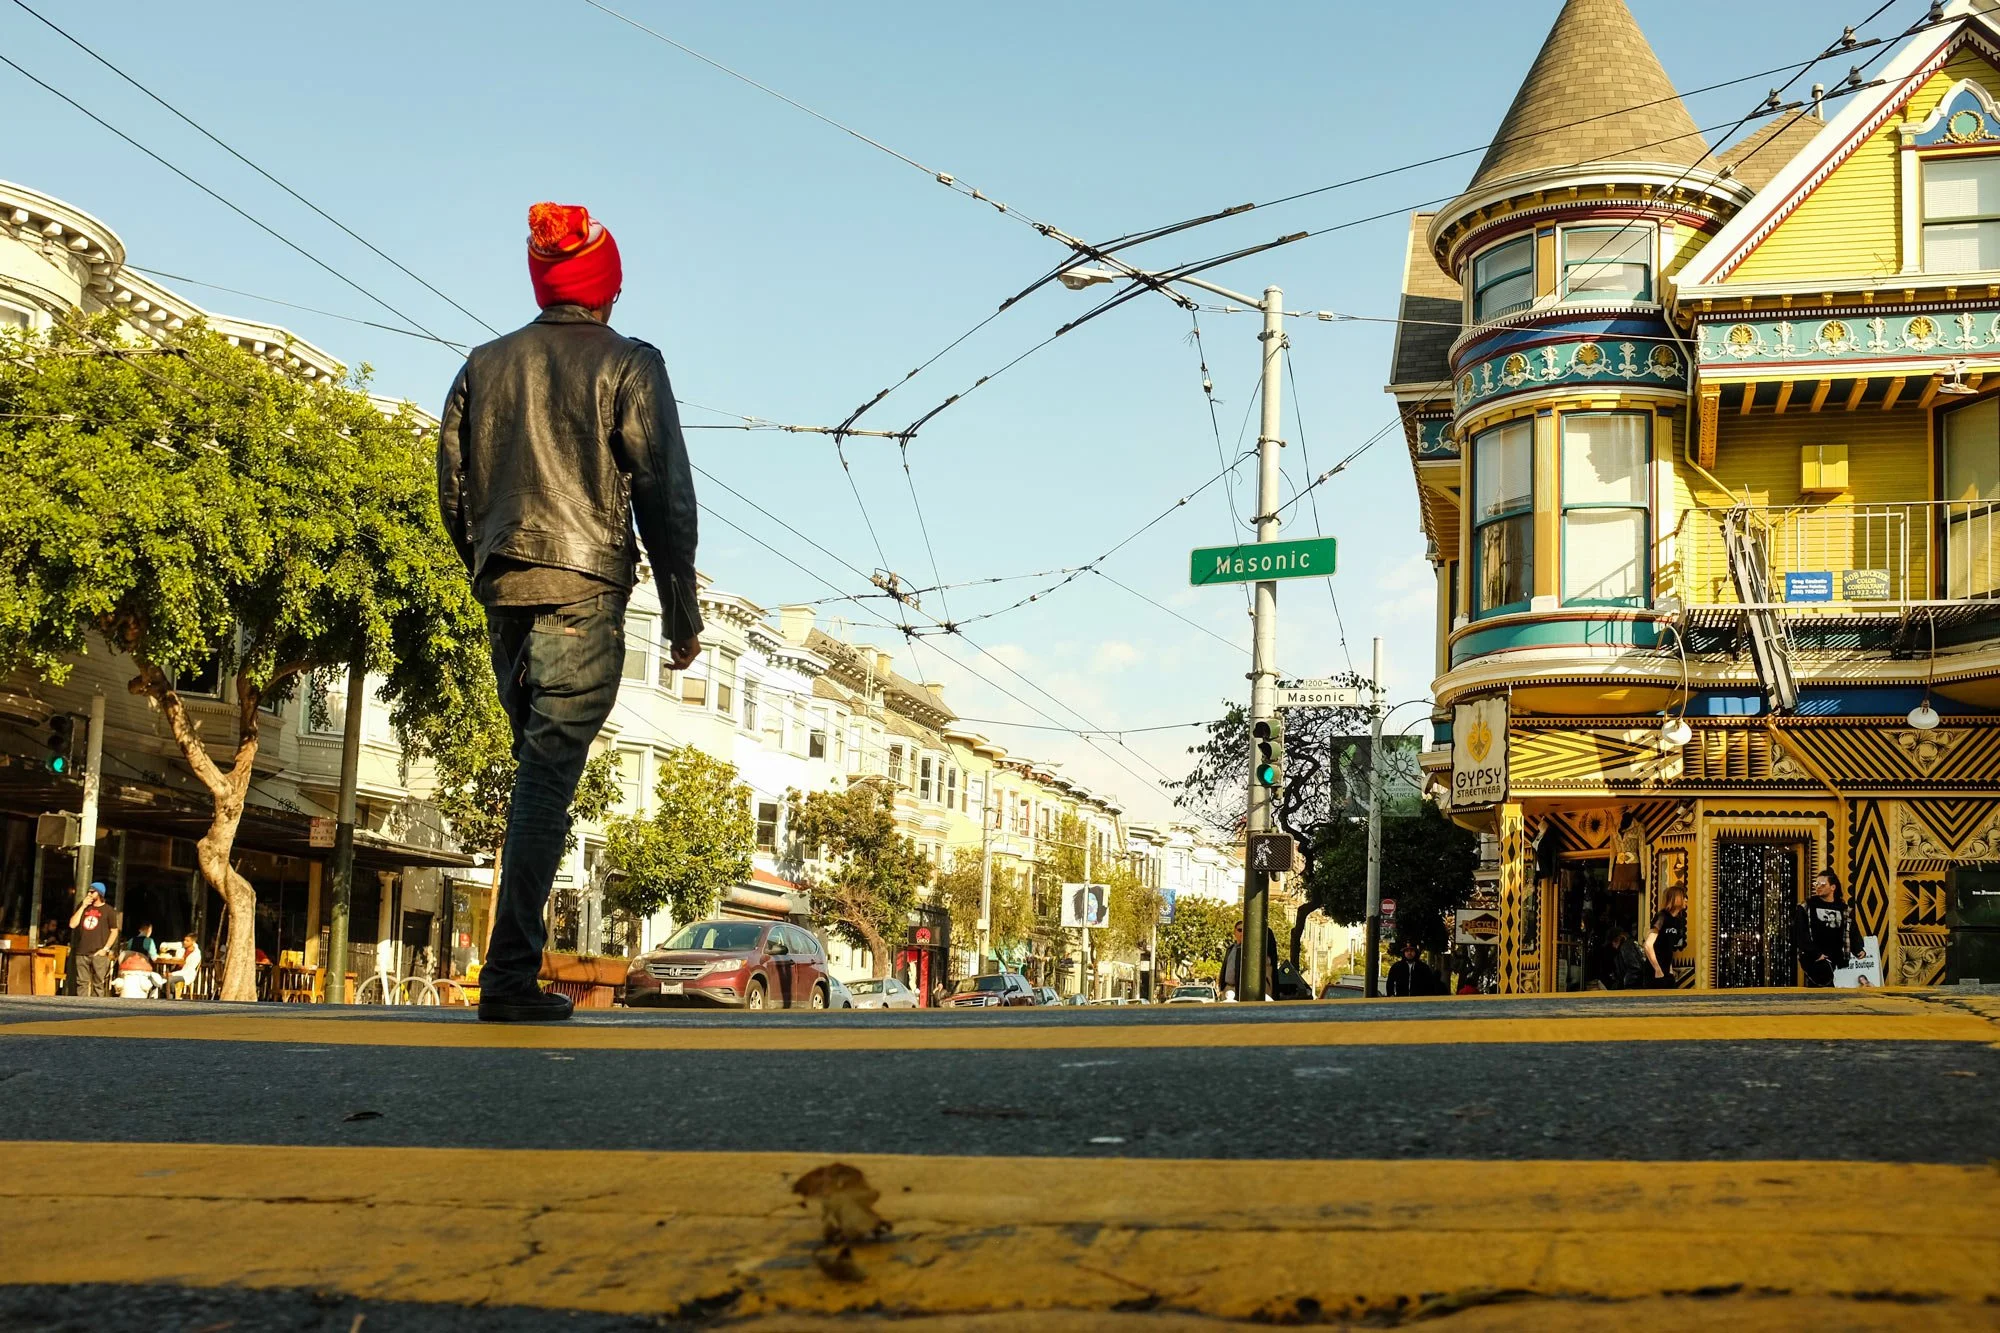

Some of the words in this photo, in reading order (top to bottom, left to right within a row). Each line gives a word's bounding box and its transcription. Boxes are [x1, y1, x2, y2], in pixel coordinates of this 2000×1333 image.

[1216, 550, 1310, 575] Masonic
[1843, 571, 1860, 583] BOB
[1287, 692, 1345, 703] Masonic
[1456, 767, 1502, 788] GYPSY
[1457, 785, 1501, 798] STREETWEAR
[1855, 960, 1875, 970] Boutique
